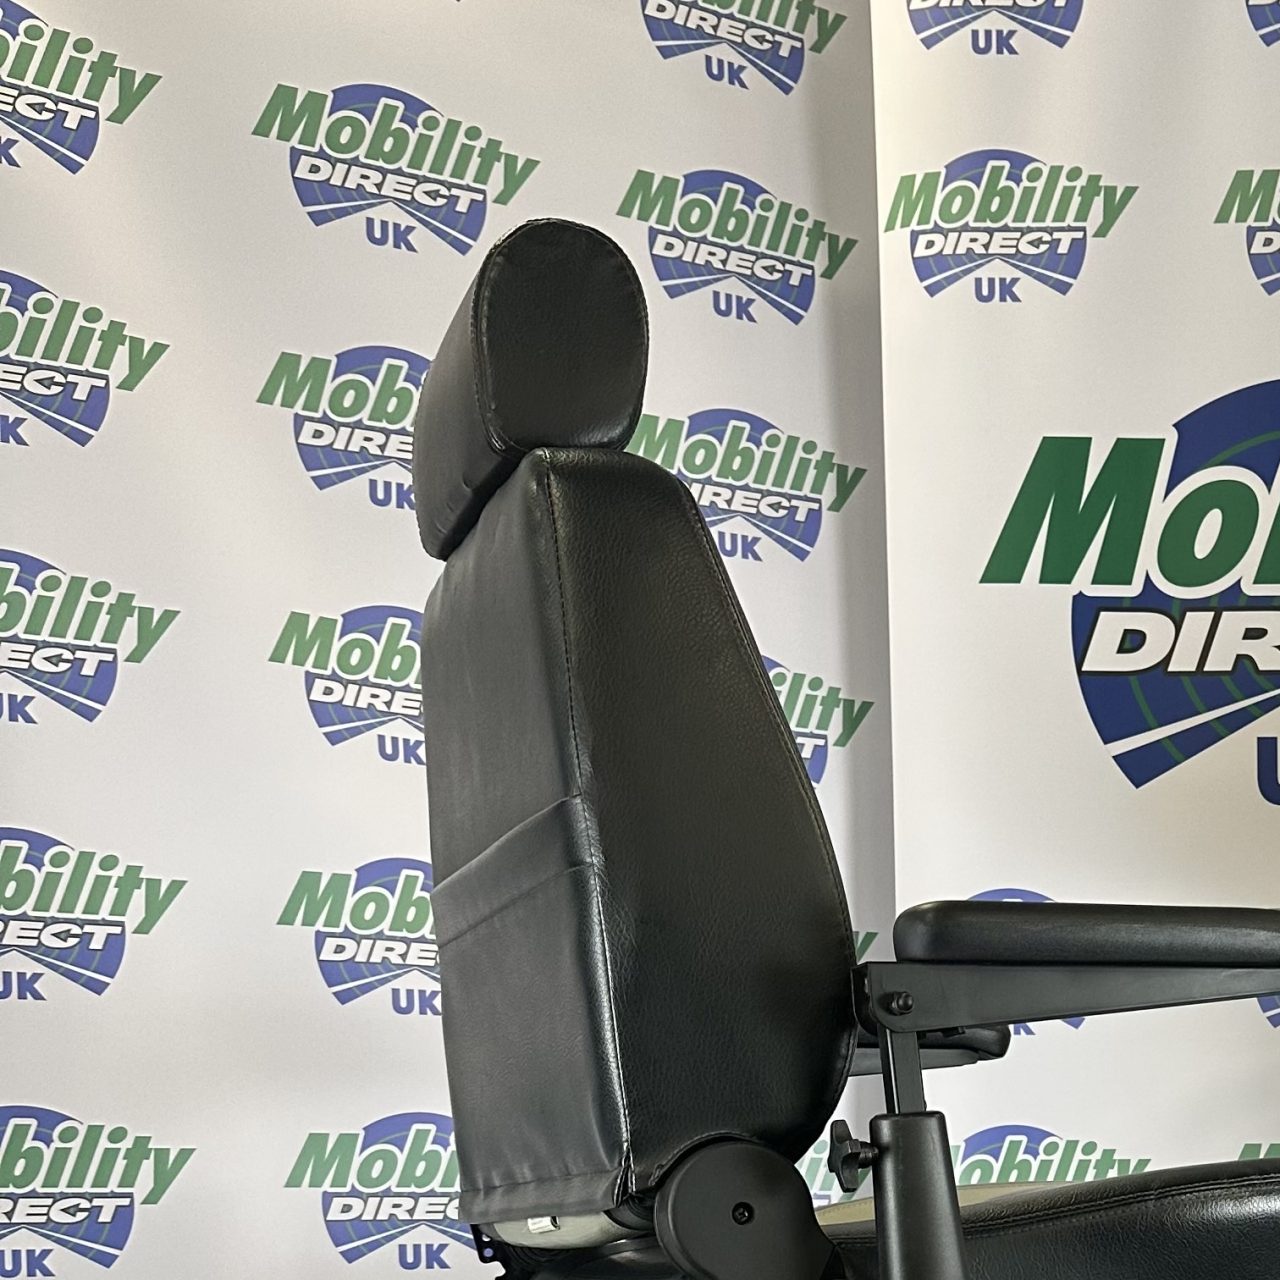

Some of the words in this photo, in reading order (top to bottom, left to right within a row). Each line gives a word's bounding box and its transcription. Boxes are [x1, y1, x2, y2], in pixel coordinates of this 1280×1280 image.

[645, 0, 803, 58] DIRECT
[971, 28, 1020, 56] UK
[0, 24, 162, 124] ility
[705, 55, 749, 90] UK
[0, 137, 21, 168] K
[252, 84, 540, 206] Mobility
[293, 156, 487, 214] DIRECT
[884, 164, 1139, 238] Mobility
[365, 218, 418, 253] UK
[616, 169, 859, 281] Mobility
[913, 230, 1086, 257] DIRECT
[651, 236, 814, 287] DIRECT
[974, 275, 1022, 303] UK
[712, 290, 758, 324] UK
[0, 288, 170, 392] ility
[0, 364, 107, 401] ECT
[0, 415, 29, 446] K
[297, 422, 414, 462] DIRE
[624, 413, 868, 513] Mobility
[368, 479, 416, 511] UK
[689, 482, 820, 522] IRECT
[718, 531, 763, 562] UK
[0, 566, 181, 664] bility
[0, 642, 115, 677] ECT
[0, 693, 38, 724] K
[309, 678, 422, 717] DIRE
[377, 734, 425, 766] UK
[0, 845, 188, 935] bility
[0, 920, 122, 950] ECT
[319, 938, 438, 968] DIRE
[391, 988, 442, 1017] UK
[0, 1123, 197, 1205] bility
[0, 1197, 131, 1223] ECT
[0, 1249, 56, 1279] UK
[399, 1243, 452, 1270] UK
